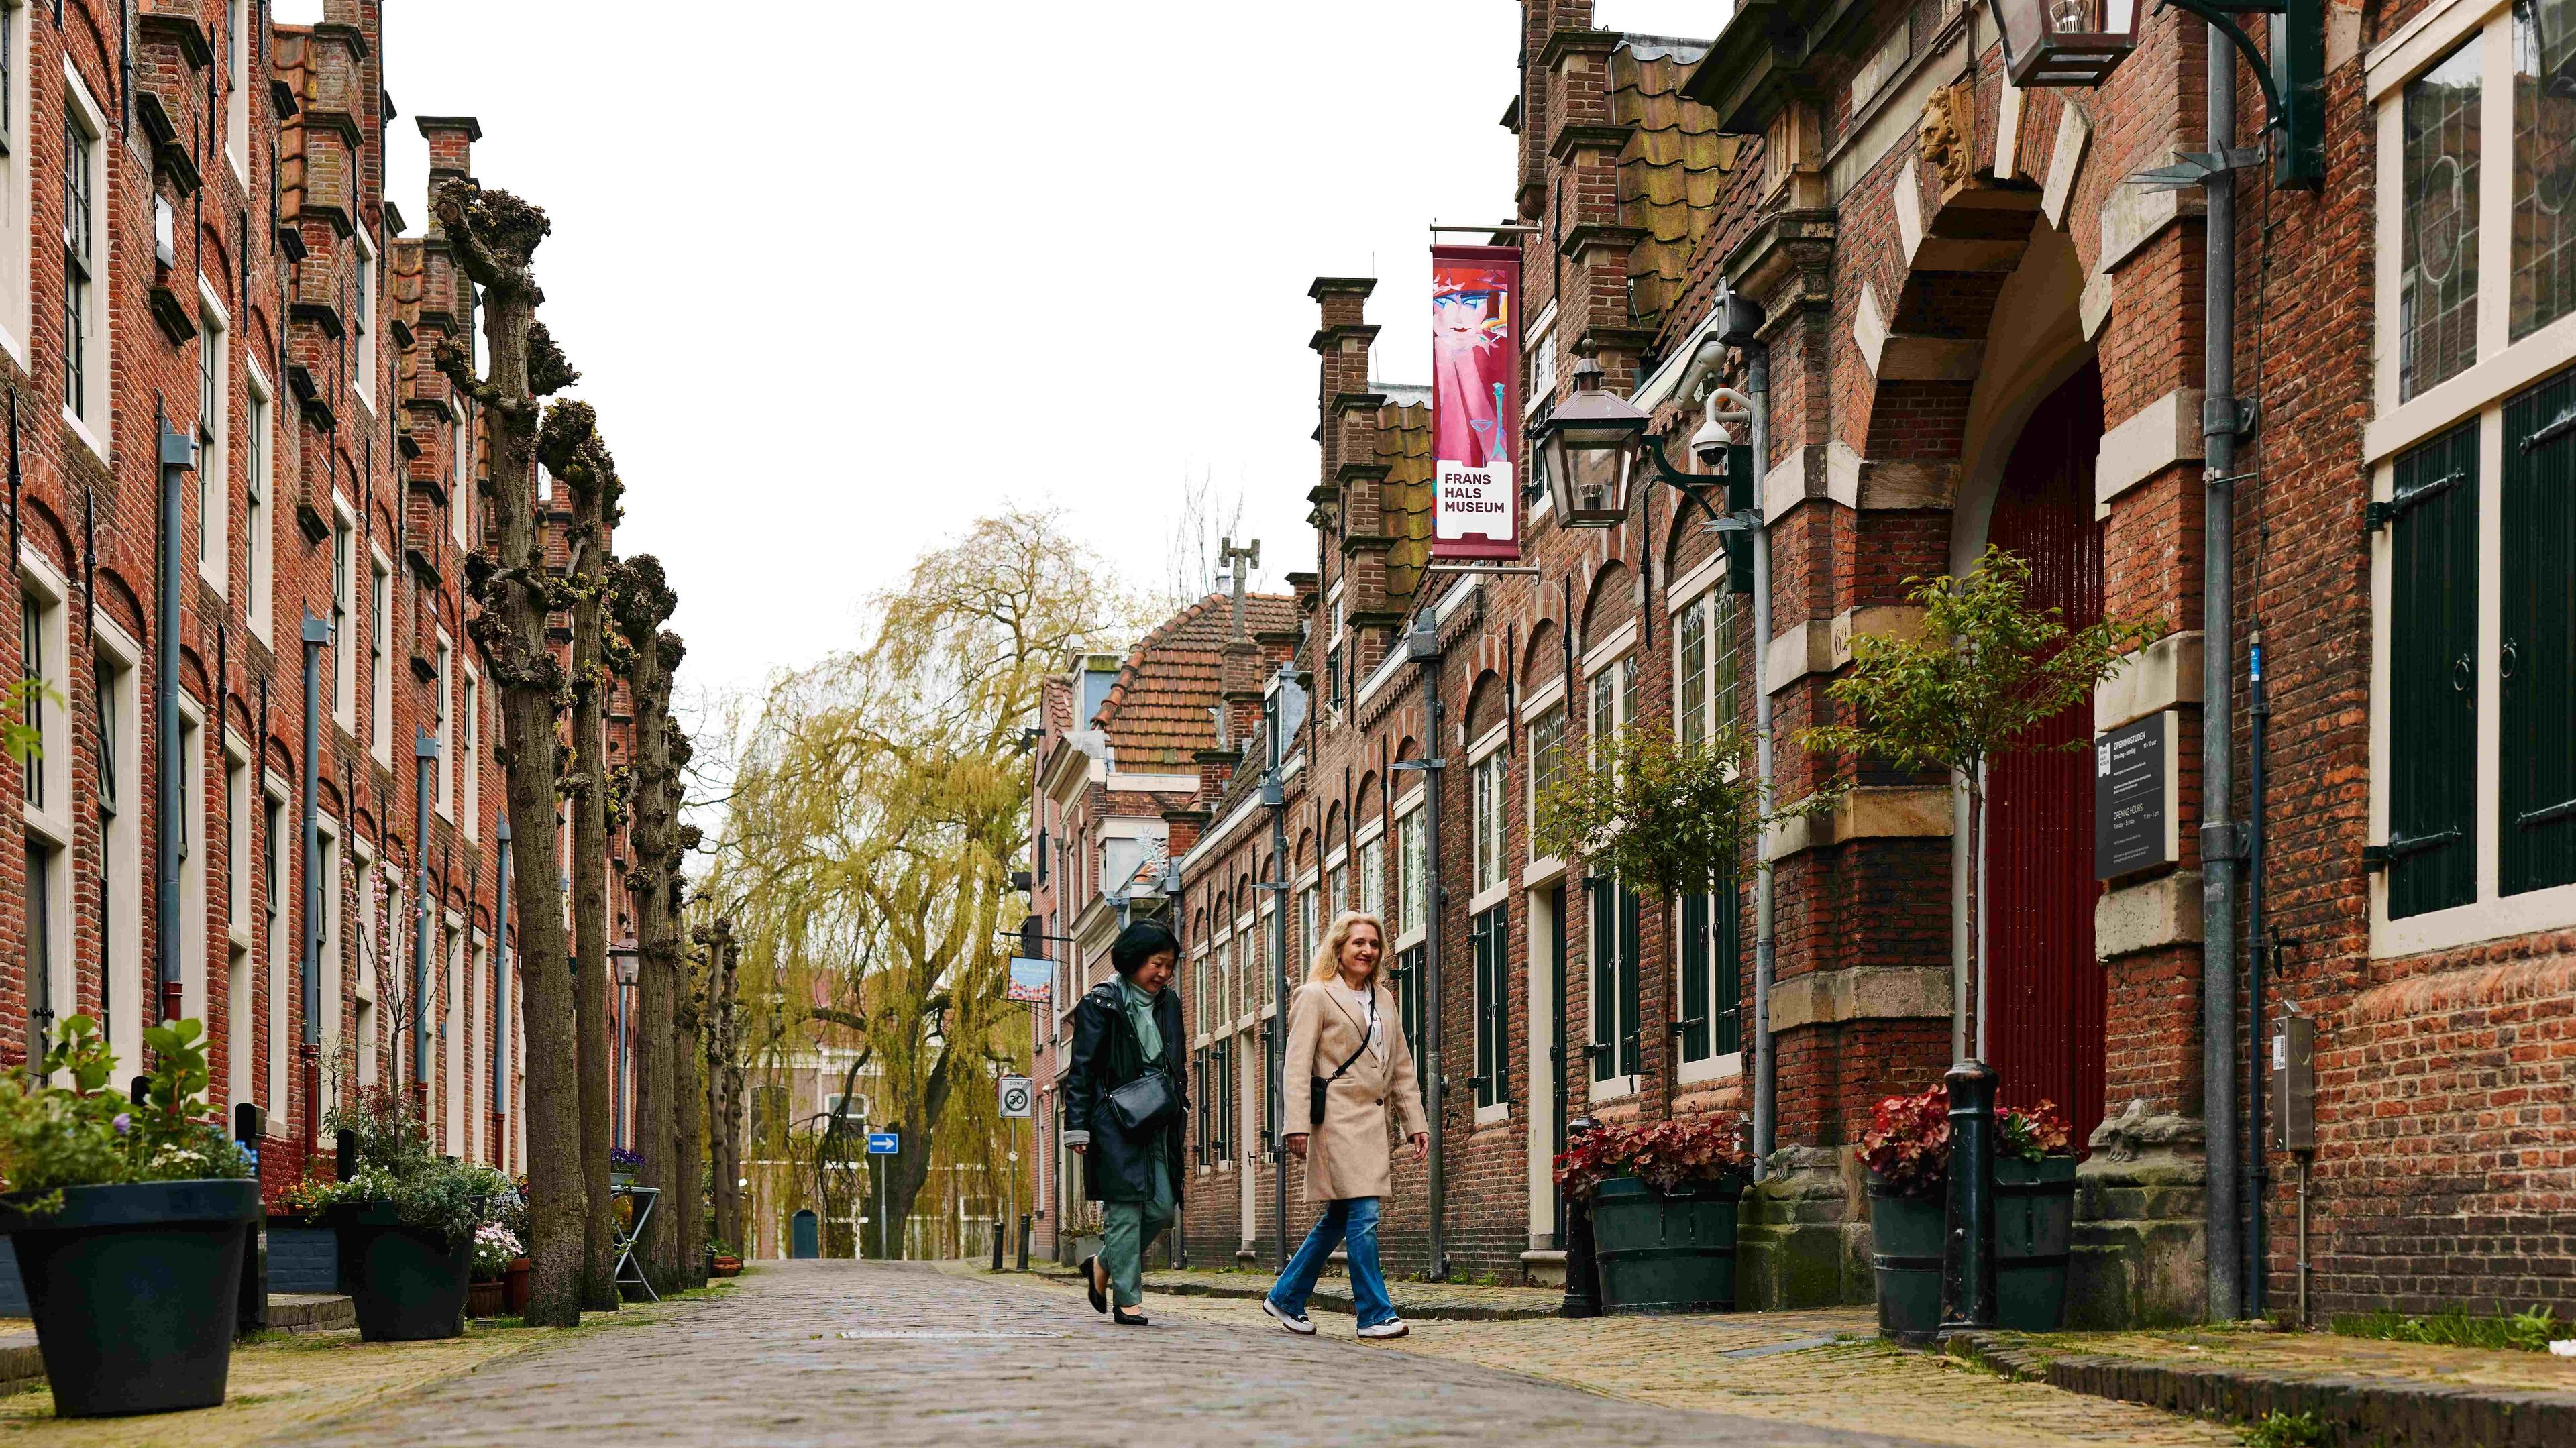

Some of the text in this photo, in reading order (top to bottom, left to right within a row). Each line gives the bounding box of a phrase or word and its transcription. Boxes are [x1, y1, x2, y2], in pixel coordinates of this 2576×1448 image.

[1444, 473, 1491, 485] FRANS
[1444, 487, 1482, 498] HALS
[1444, 501, 1505, 514] MUSEUM
[2114, 803, 2143, 820] OPENING HOURS
[1009, 1095, 1024, 1105] 30
